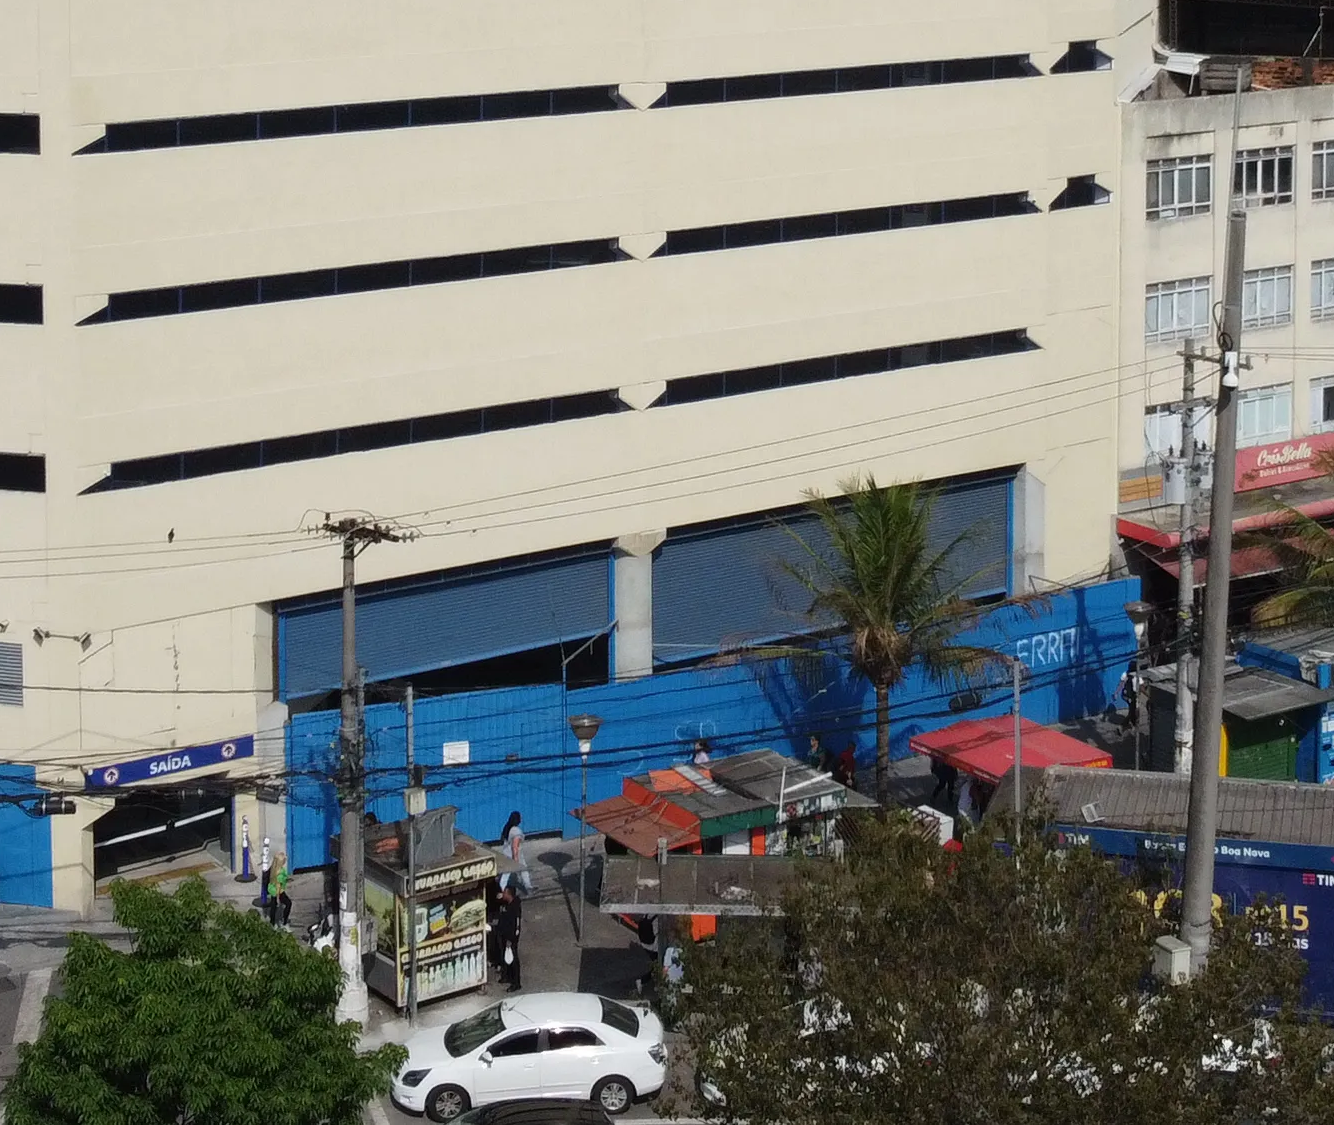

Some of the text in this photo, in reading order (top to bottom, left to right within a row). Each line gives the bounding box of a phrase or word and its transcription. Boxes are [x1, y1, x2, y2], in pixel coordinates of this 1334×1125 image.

[149, 755, 192, 776] SAÍDA
[1221, 845, 1270, 859] Boa Nova
